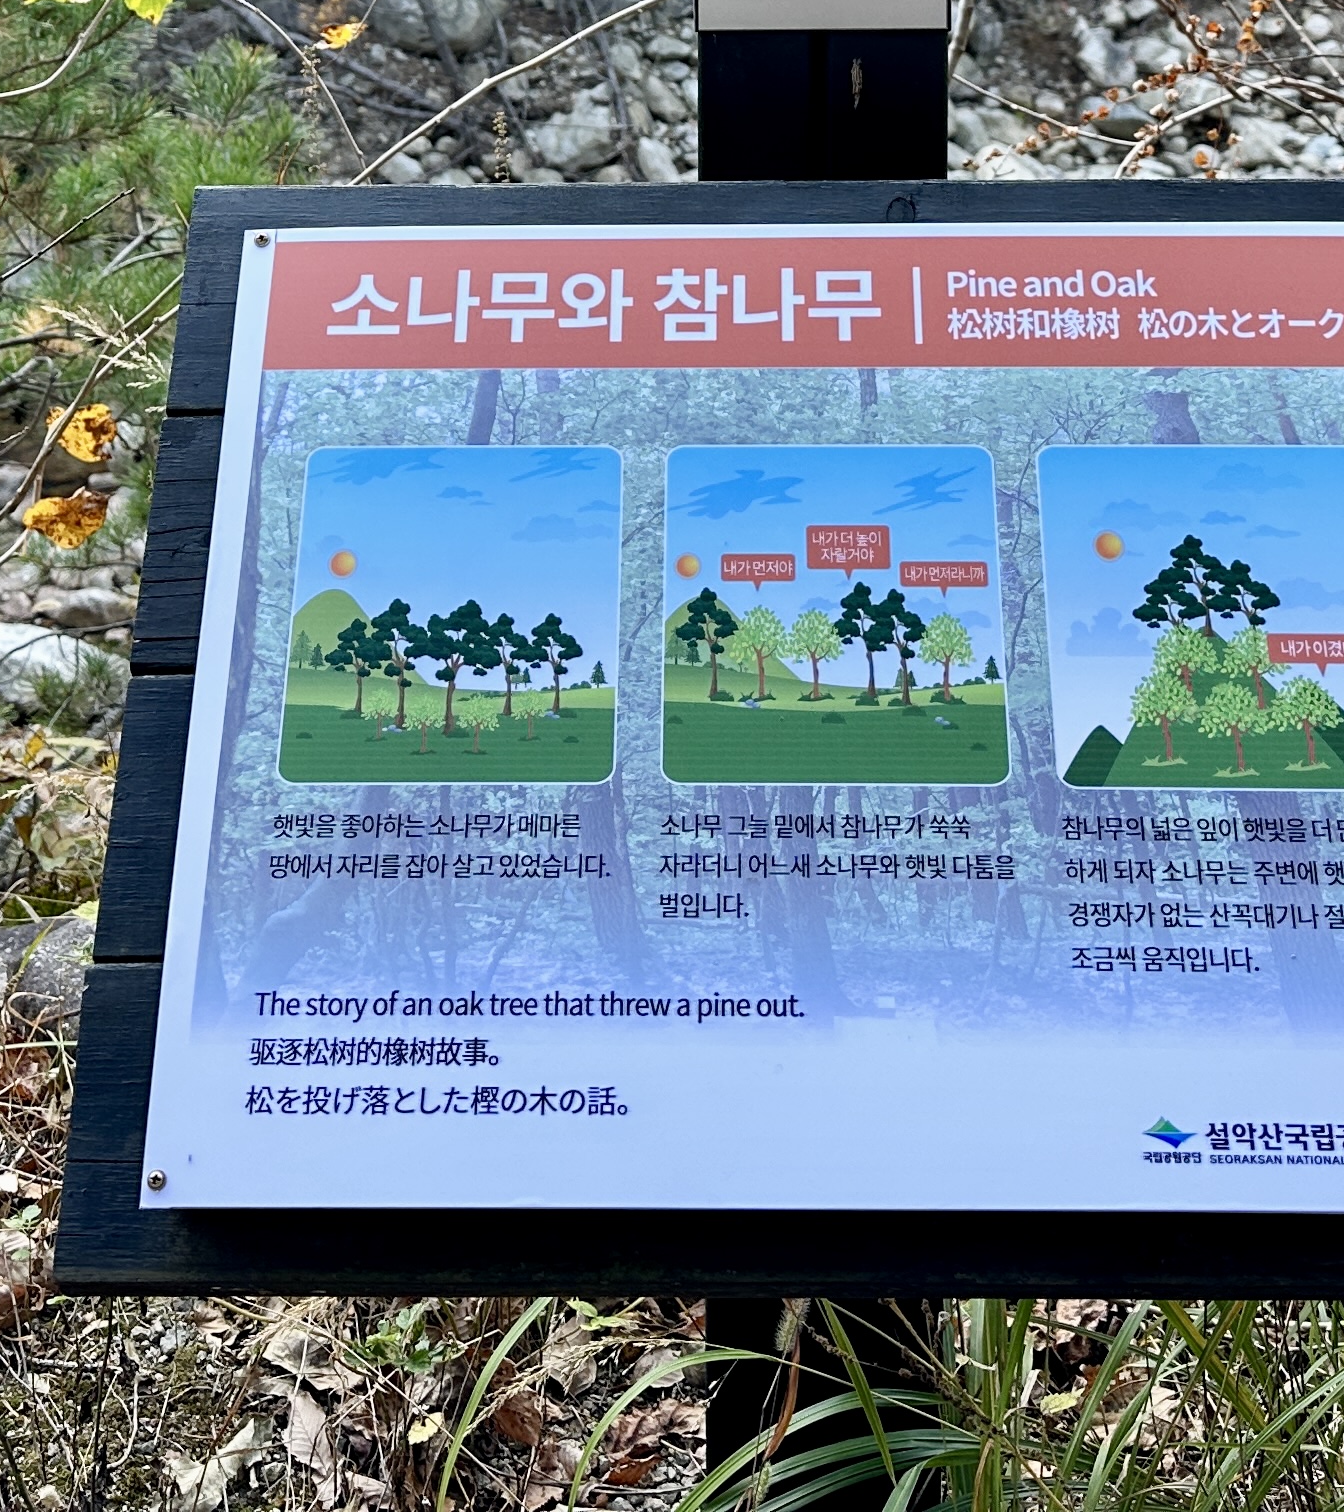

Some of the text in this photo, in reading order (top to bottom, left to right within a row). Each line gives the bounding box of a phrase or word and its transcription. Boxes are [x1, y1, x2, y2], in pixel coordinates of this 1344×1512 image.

[947, 270, 1158, 298] Pine and Oak
[326, 267, 882, 343] 소나무와 참나무
[947, 307, 1120, 340] 松树和橡树
[1137, 307, 1344, 340] 松の木とオーク
[812, 531, 882, 546] 내가 더 높이
[723, 560, 793, 576] 내가 먼저야
[1281, 640, 1311, 657] 내가
[273, 814, 581, 839] 햇빛을 좋아하는 소나무가 메마른
[660, 814, 971, 839] 소나무 그늘 밑에서 참나무가 쑥쑥
[1061, 816, 1144, 841] 참나무의
[1151, 817, 1192, 841] 넓은
[1197, 817, 1238, 842] 잎이
[1243, 817, 1307, 842] 햇빛을
[1312, 818, 1332, 842] 더
[270, 854, 611, 879] 땅에서 자리를 잡아 살고 있었습니다.
[659, 853, 1016, 880] 자라더니 어느새 소나무와 햇빛 다툼을
[1064, 859, 1107, 884] 하게
[1114, 859, 1155, 884] 되자
[1162, 860, 1248, 884] 소나무는
[1254, 861, 1318, 885] 주변에
[659, 893, 749, 918] 벌입니다.
[1068, 903, 1154, 927] 경쟁자가
[1161, 903, 1205, 928] 없는
[1210, 904, 1319, 929] 산꼭대기나
[1071, 946, 1260, 973] 조금씩 움직입니다.
[256, 991, 805, 1023] The story of an oak tree that threw a pine out.
[249, 1037, 499, 1066] 驱逐松树的橡树故事。
[245, 1086, 629, 1116] 松を投げ落とした樫の木の話。
[1210, 1154, 1282, 1165] SEORAKSAN
